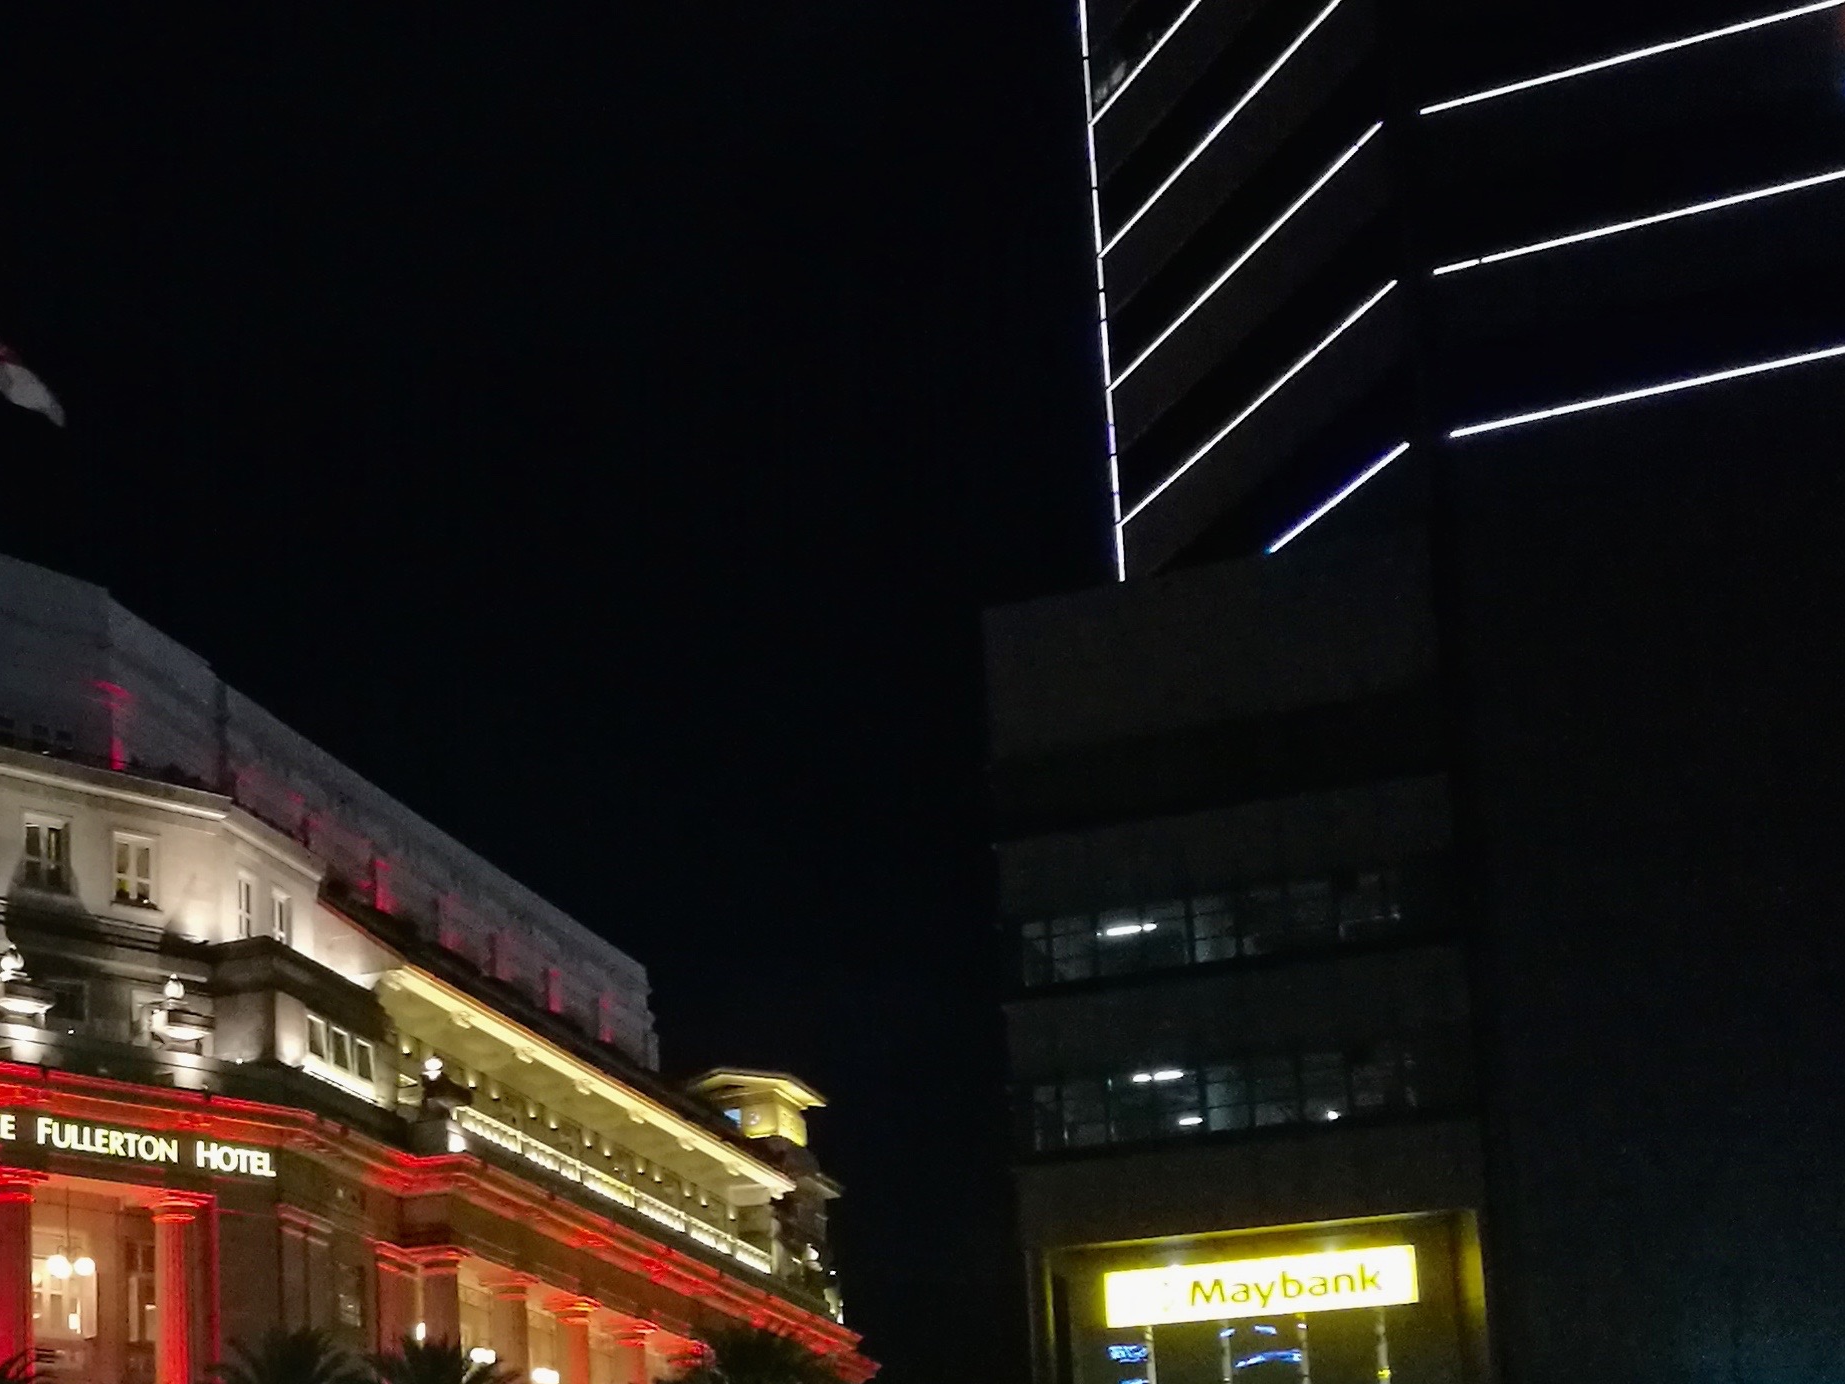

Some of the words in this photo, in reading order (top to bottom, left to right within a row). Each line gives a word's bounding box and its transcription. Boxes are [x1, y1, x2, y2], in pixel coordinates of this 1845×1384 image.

[36, 1116, 178, 1164] FULLERTON
[195, 1140, 277, 1178] HOTEL
[1190, 1264, 1381, 1308] Maybank
